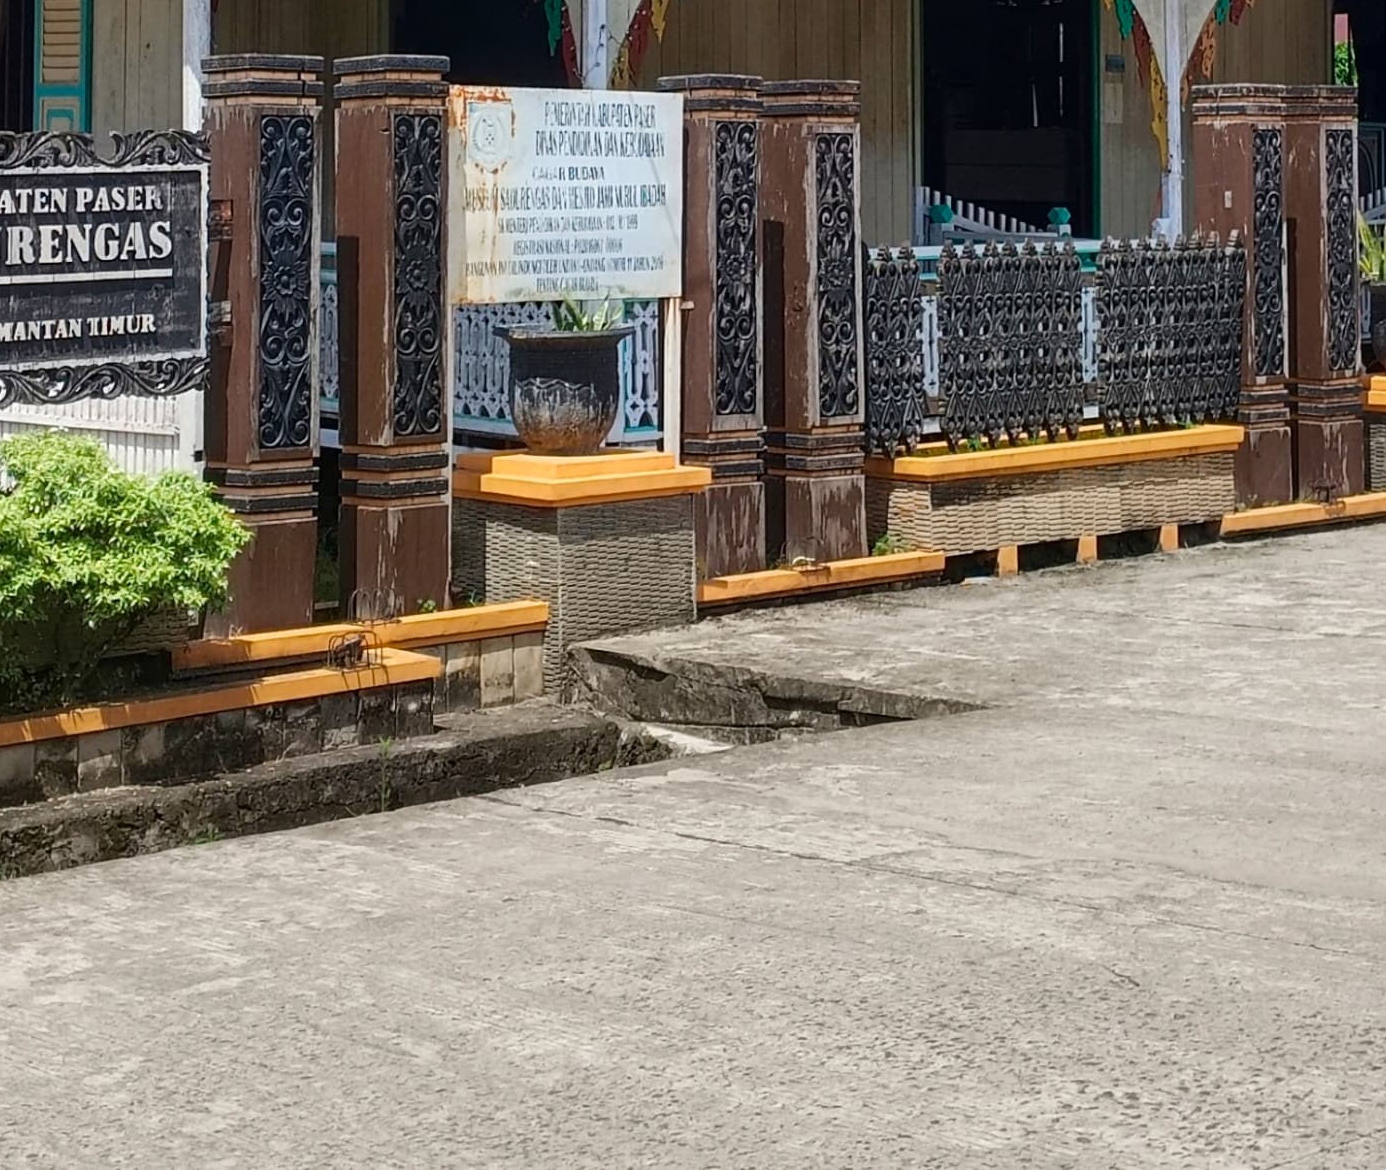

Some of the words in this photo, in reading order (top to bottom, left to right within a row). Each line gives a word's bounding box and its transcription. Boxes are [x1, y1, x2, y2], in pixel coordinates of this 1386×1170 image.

[544, 101, 591, 127] PEMERINTAH
[568, 166, 605, 181] BUDAYA
[75, 185, 164, 213] PASER
[87, 312, 156, 337] TIMUR
